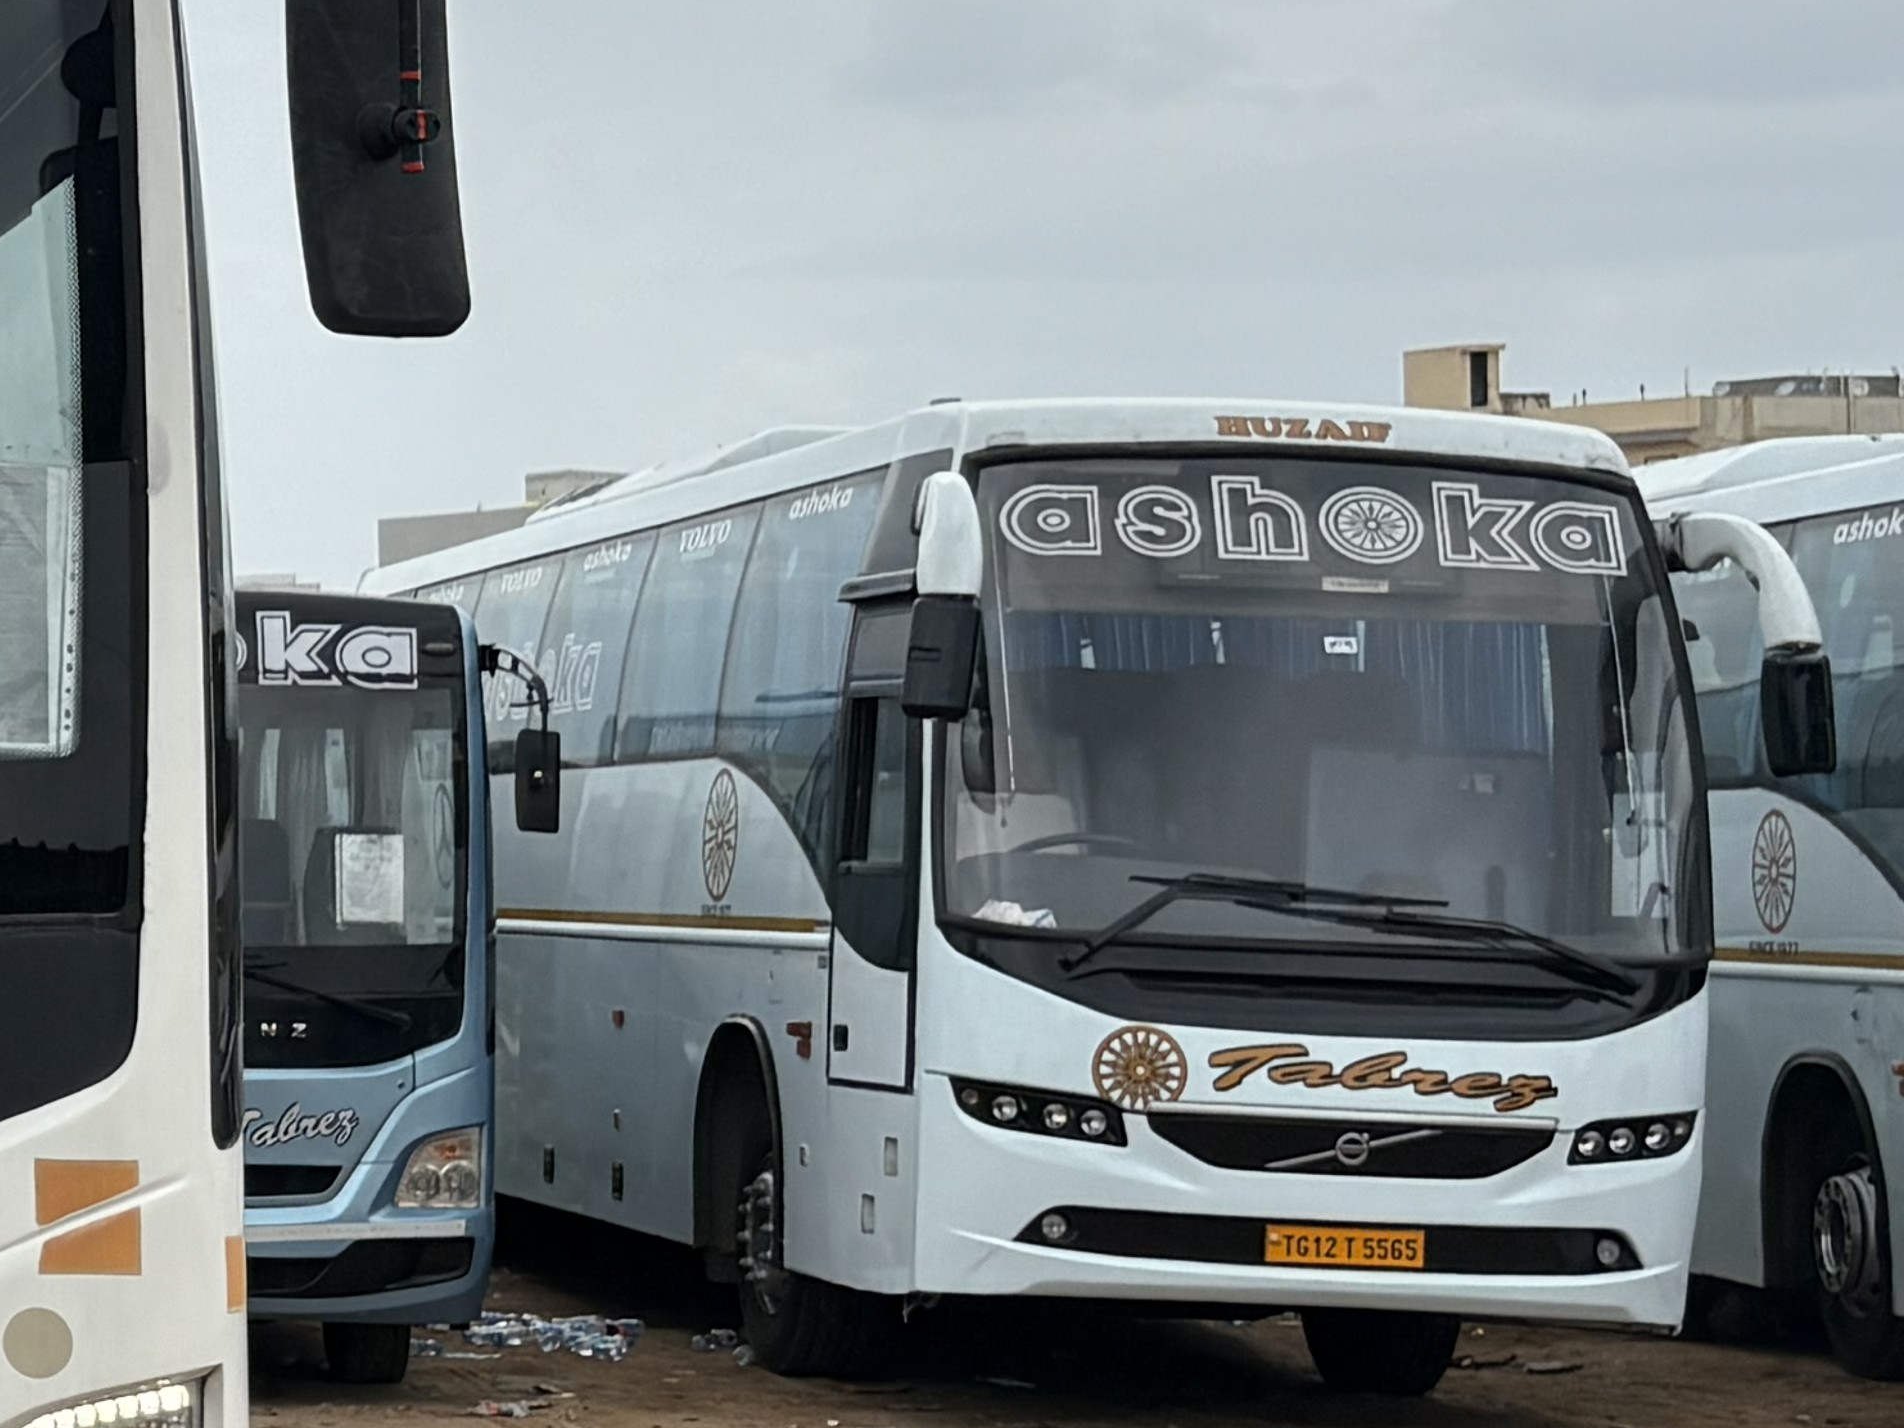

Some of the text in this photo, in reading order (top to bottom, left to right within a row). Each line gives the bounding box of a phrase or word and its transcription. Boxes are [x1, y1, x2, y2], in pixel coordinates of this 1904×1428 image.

[789, 483, 854, 520] ashoka
[679, 519, 732, 553] VOLVO
[999, 475, 1627, 577] ashoka
[1208, 1043, 1558, 1112] Tabrez
[1283, 1235, 1418, 1261] TG12 T 5565
